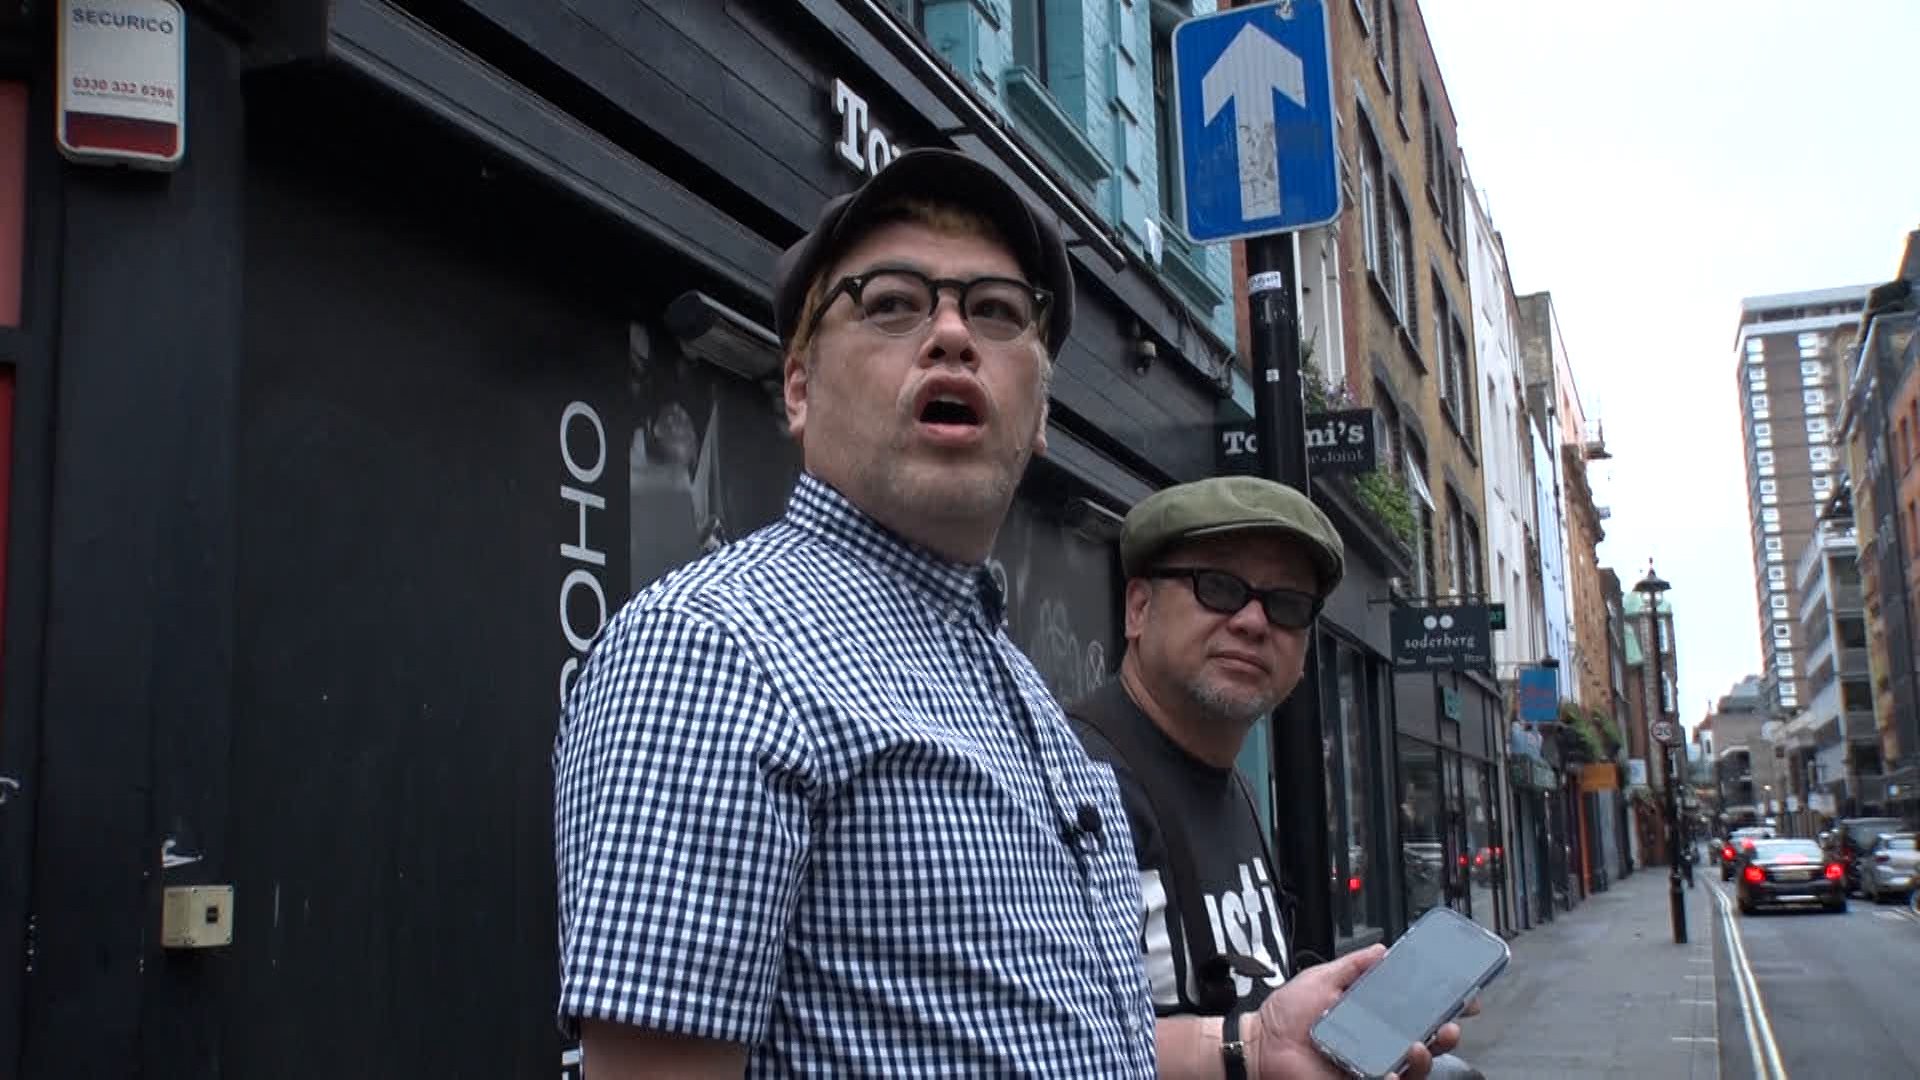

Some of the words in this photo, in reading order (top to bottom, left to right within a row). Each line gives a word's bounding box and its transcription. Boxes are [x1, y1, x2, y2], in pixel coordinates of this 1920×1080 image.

[72, 8, 174, 34] SECURICO
[111, 80, 137, 94] 332
[1222, 420, 1366, 455] Toi's
